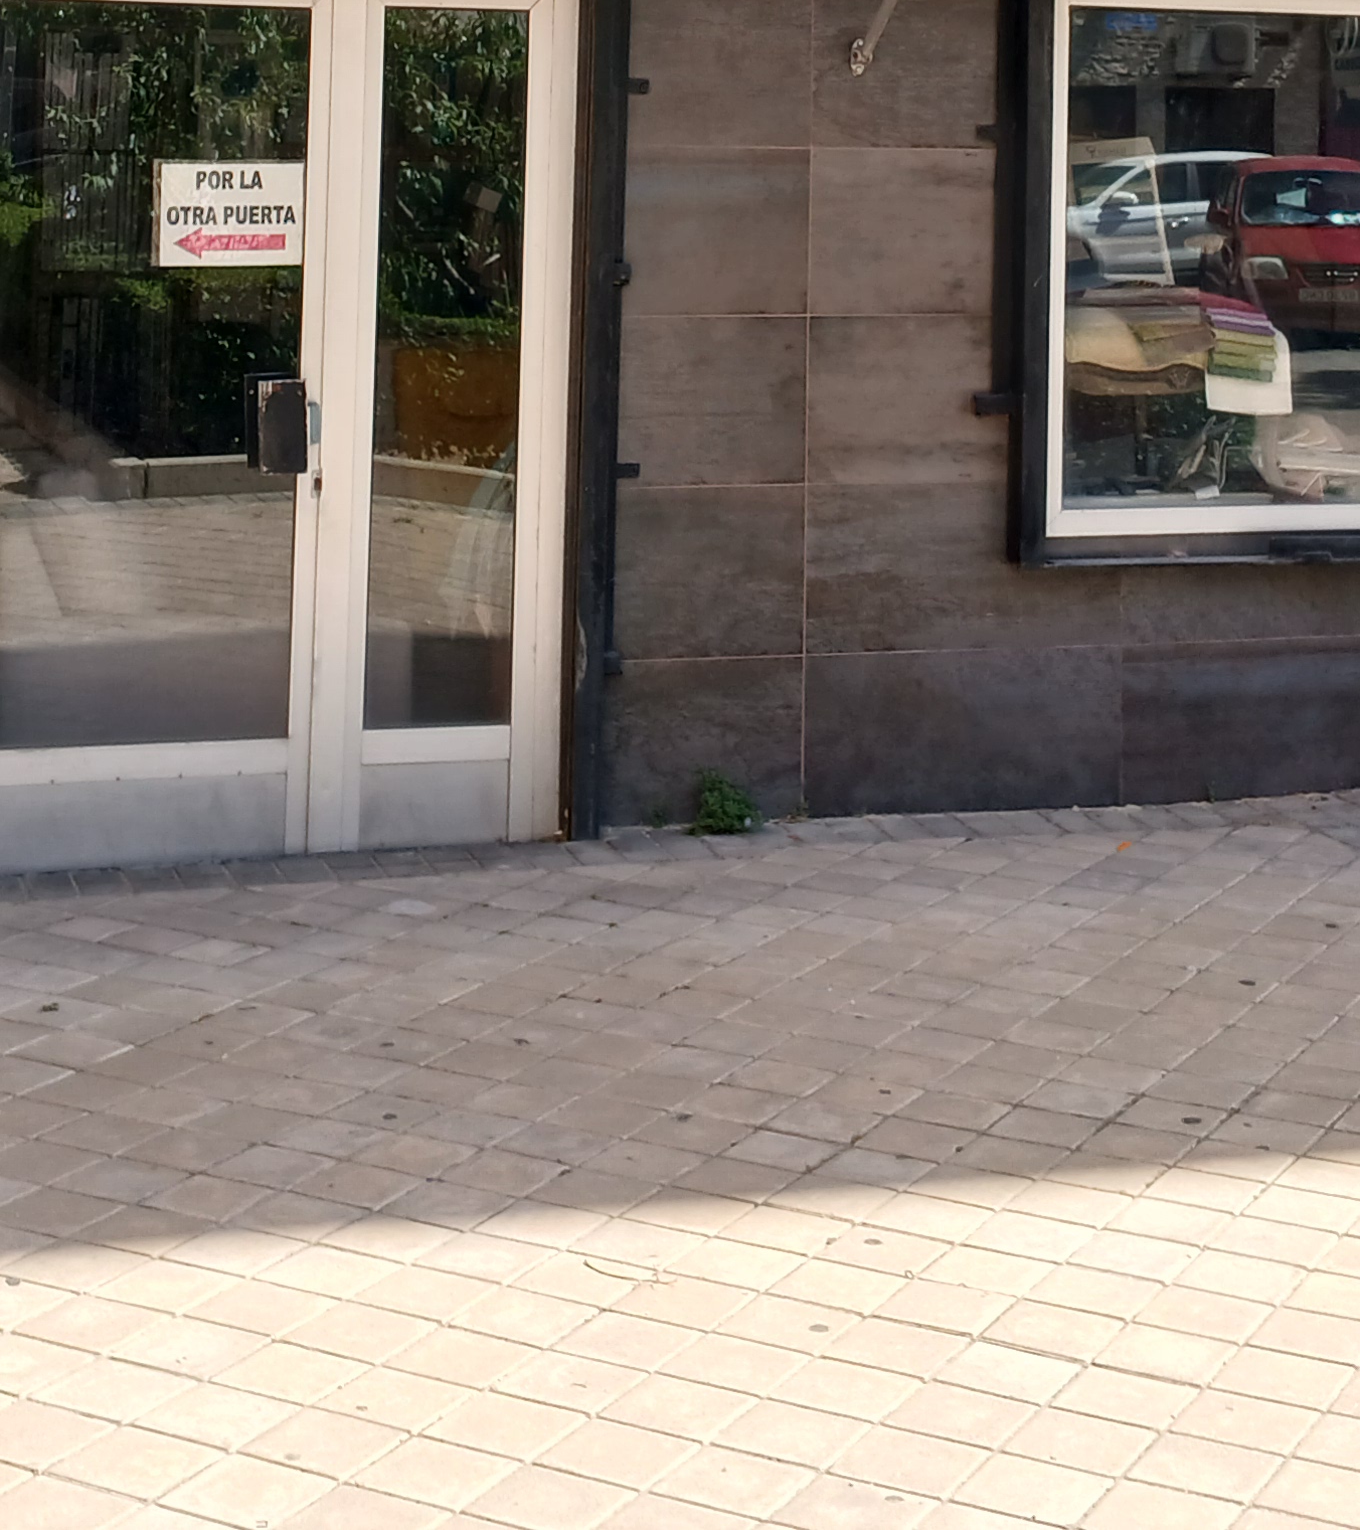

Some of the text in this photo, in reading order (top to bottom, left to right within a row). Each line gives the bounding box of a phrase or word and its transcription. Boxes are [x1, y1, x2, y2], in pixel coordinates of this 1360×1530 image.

[196, 170, 263, 190] POR LA
[166, 205, 296, 226] OTRA PUERTA
